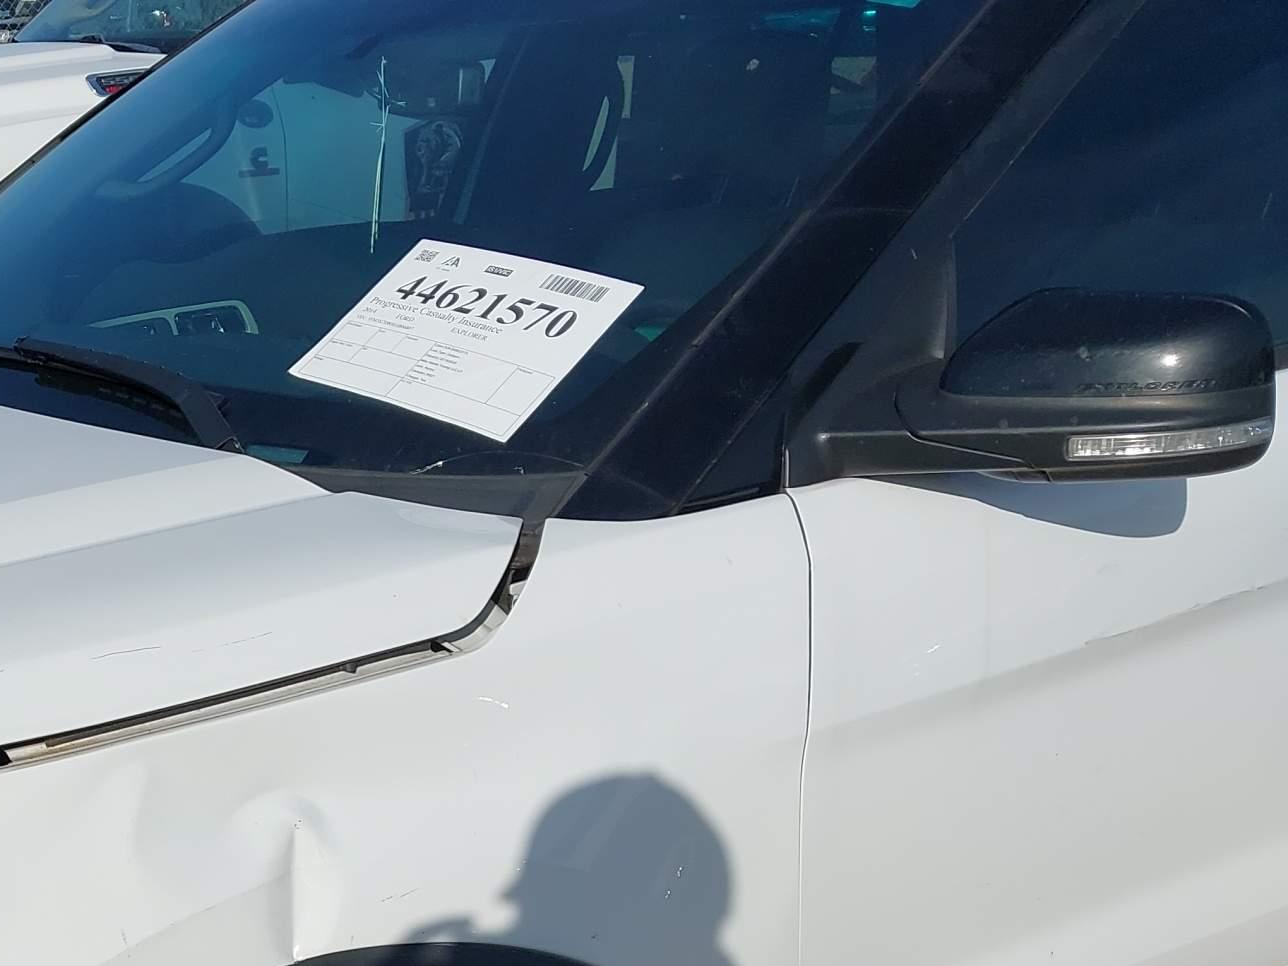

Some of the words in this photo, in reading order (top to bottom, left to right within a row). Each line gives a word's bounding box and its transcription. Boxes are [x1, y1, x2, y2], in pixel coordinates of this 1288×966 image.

[370, 295, 419, 314] Progressive
[418, 306, 460, 324] Casualty
[457, 315, 504, 335] Insurance
[395, 275, 578, 339] 44621570
[450, 326, 489, 342] EXPLORER
